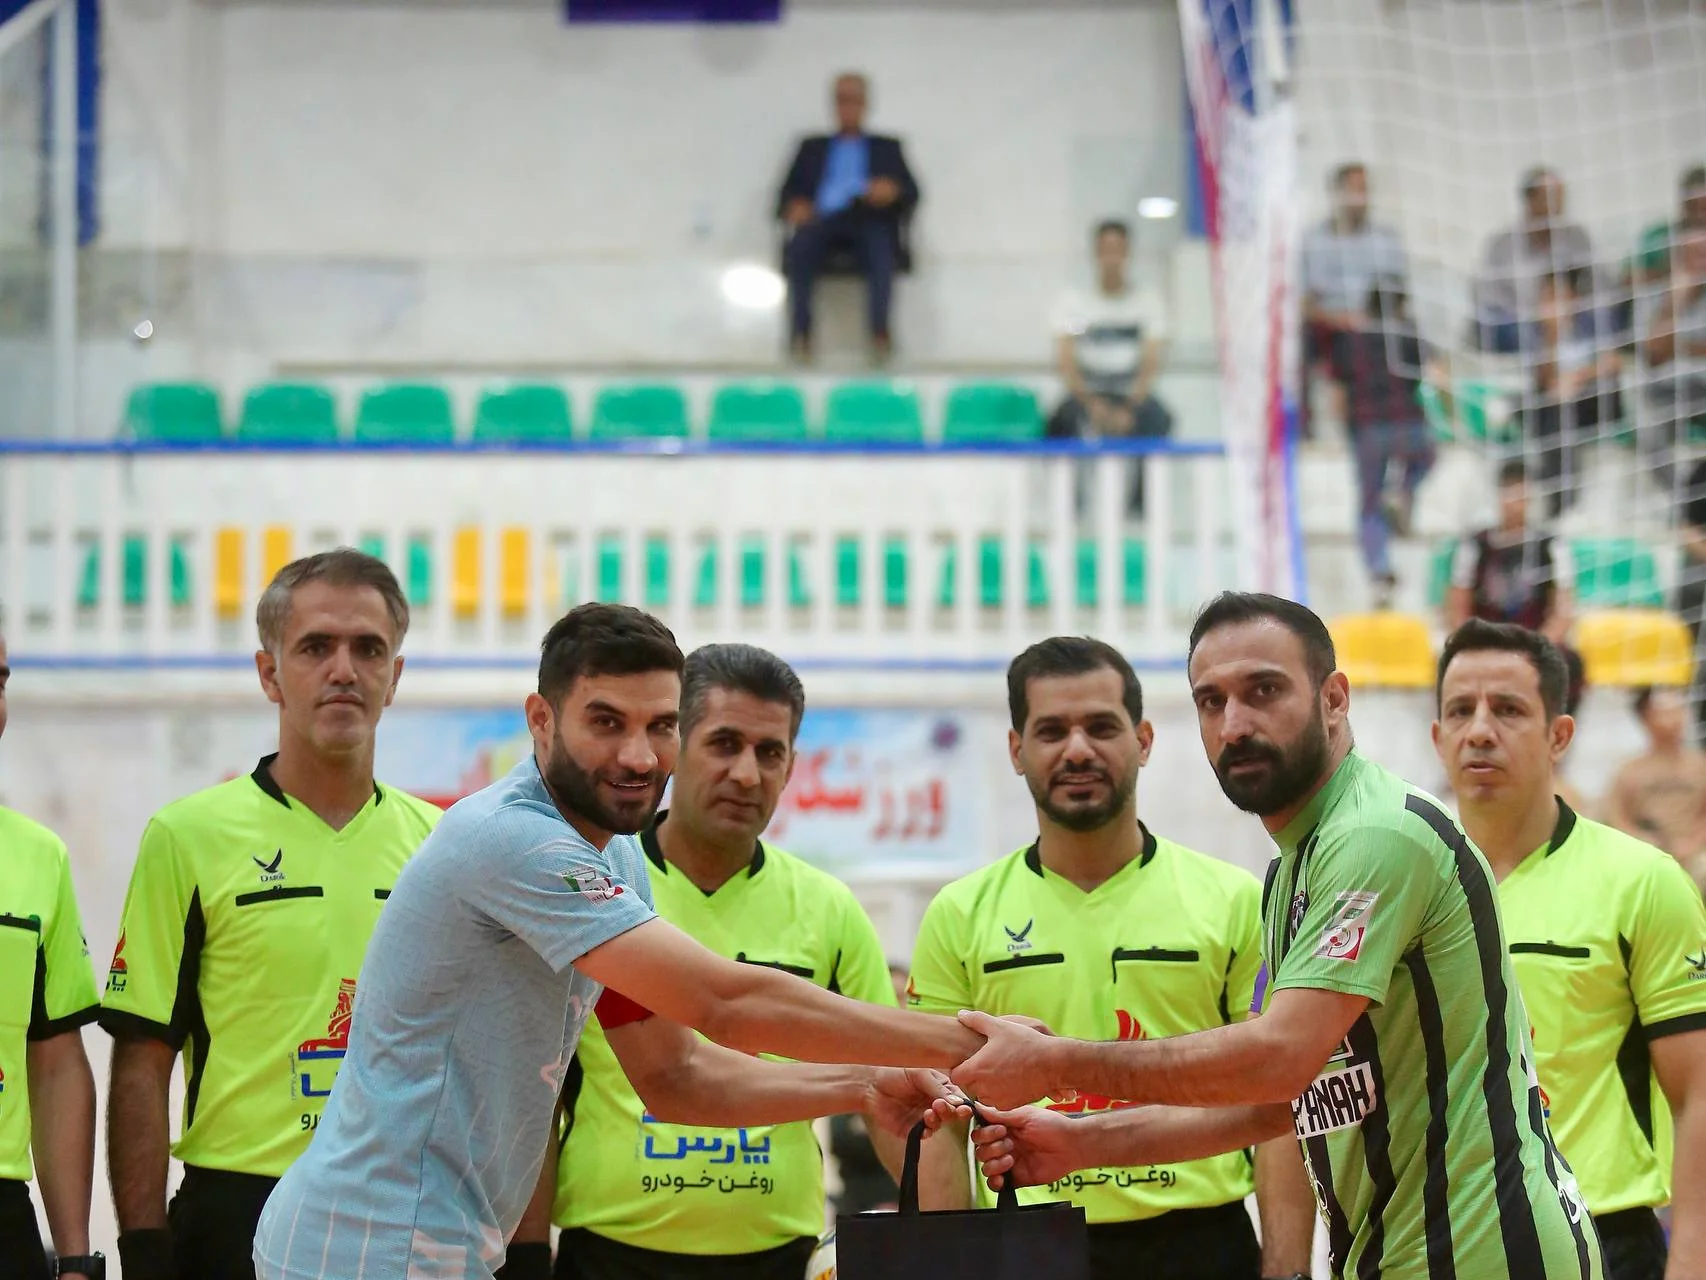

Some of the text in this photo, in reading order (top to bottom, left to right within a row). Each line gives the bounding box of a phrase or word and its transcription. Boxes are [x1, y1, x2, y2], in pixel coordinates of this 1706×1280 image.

[644, 1128, 770, 1164] پارس
[642, 1169, 774, 1194] روغن خودرو
